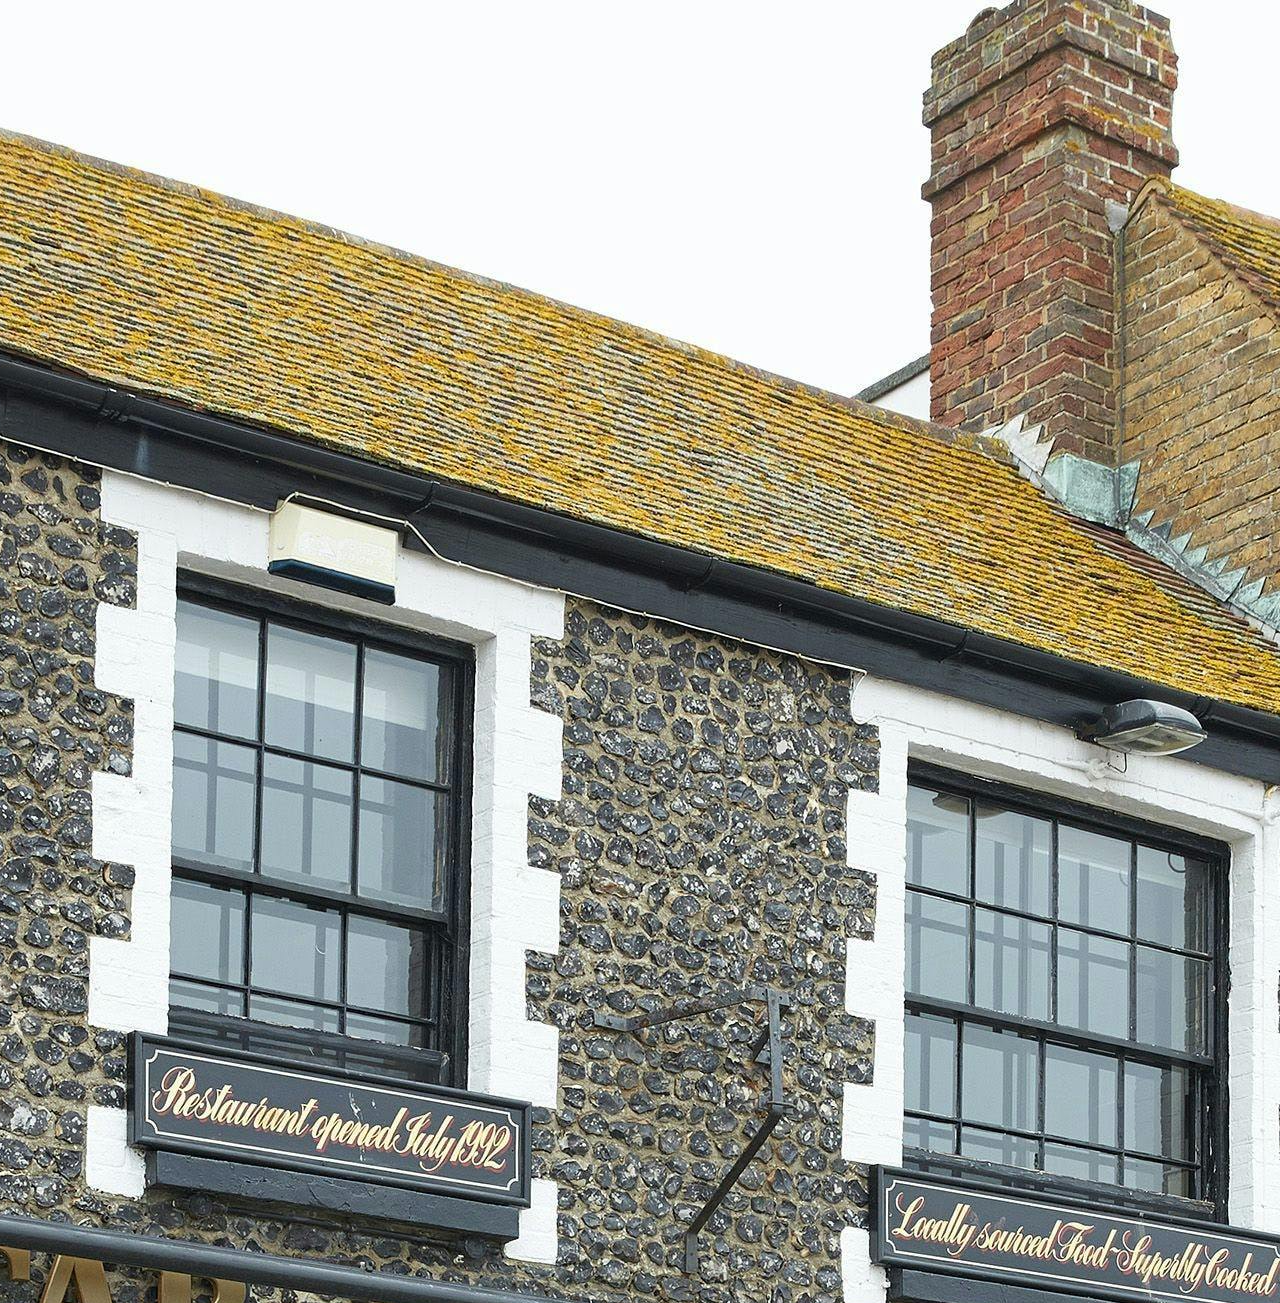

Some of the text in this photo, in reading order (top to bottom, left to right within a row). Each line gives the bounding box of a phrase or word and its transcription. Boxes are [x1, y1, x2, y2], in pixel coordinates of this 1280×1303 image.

[152, 1066, 512, 1172] Restaurant opened July 1992
[891, 1191, 977, 1257] Locally
[976, 1219, 1062, 1259] sourced
[1052, 1221, 1116, 1269] Food
[1116, 1229, 1207, 1294] Superbly
